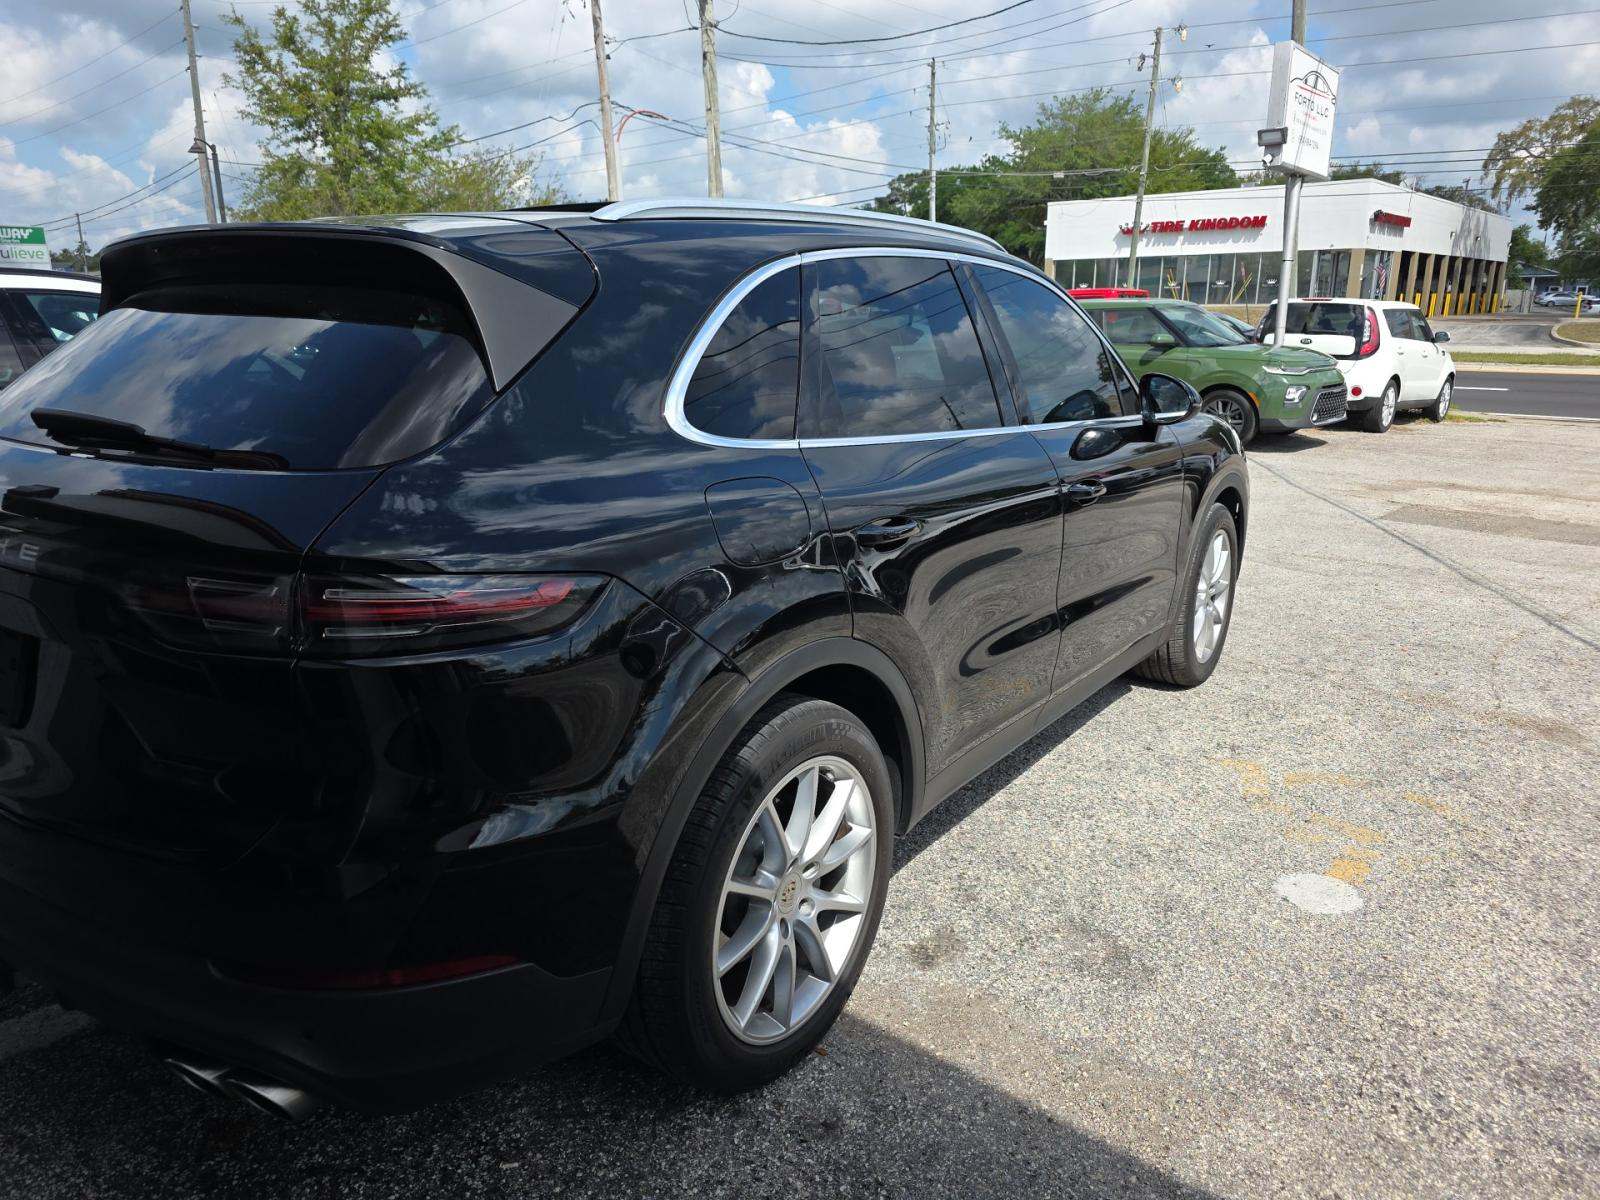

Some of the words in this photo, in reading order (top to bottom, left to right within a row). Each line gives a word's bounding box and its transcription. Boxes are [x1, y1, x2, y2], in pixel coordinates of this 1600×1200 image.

[1316, 103, 1329, 118] LLC
[1151, 220, 1185, 233] TIRE
[1189, 215, 1268, 232] KINGDOM
